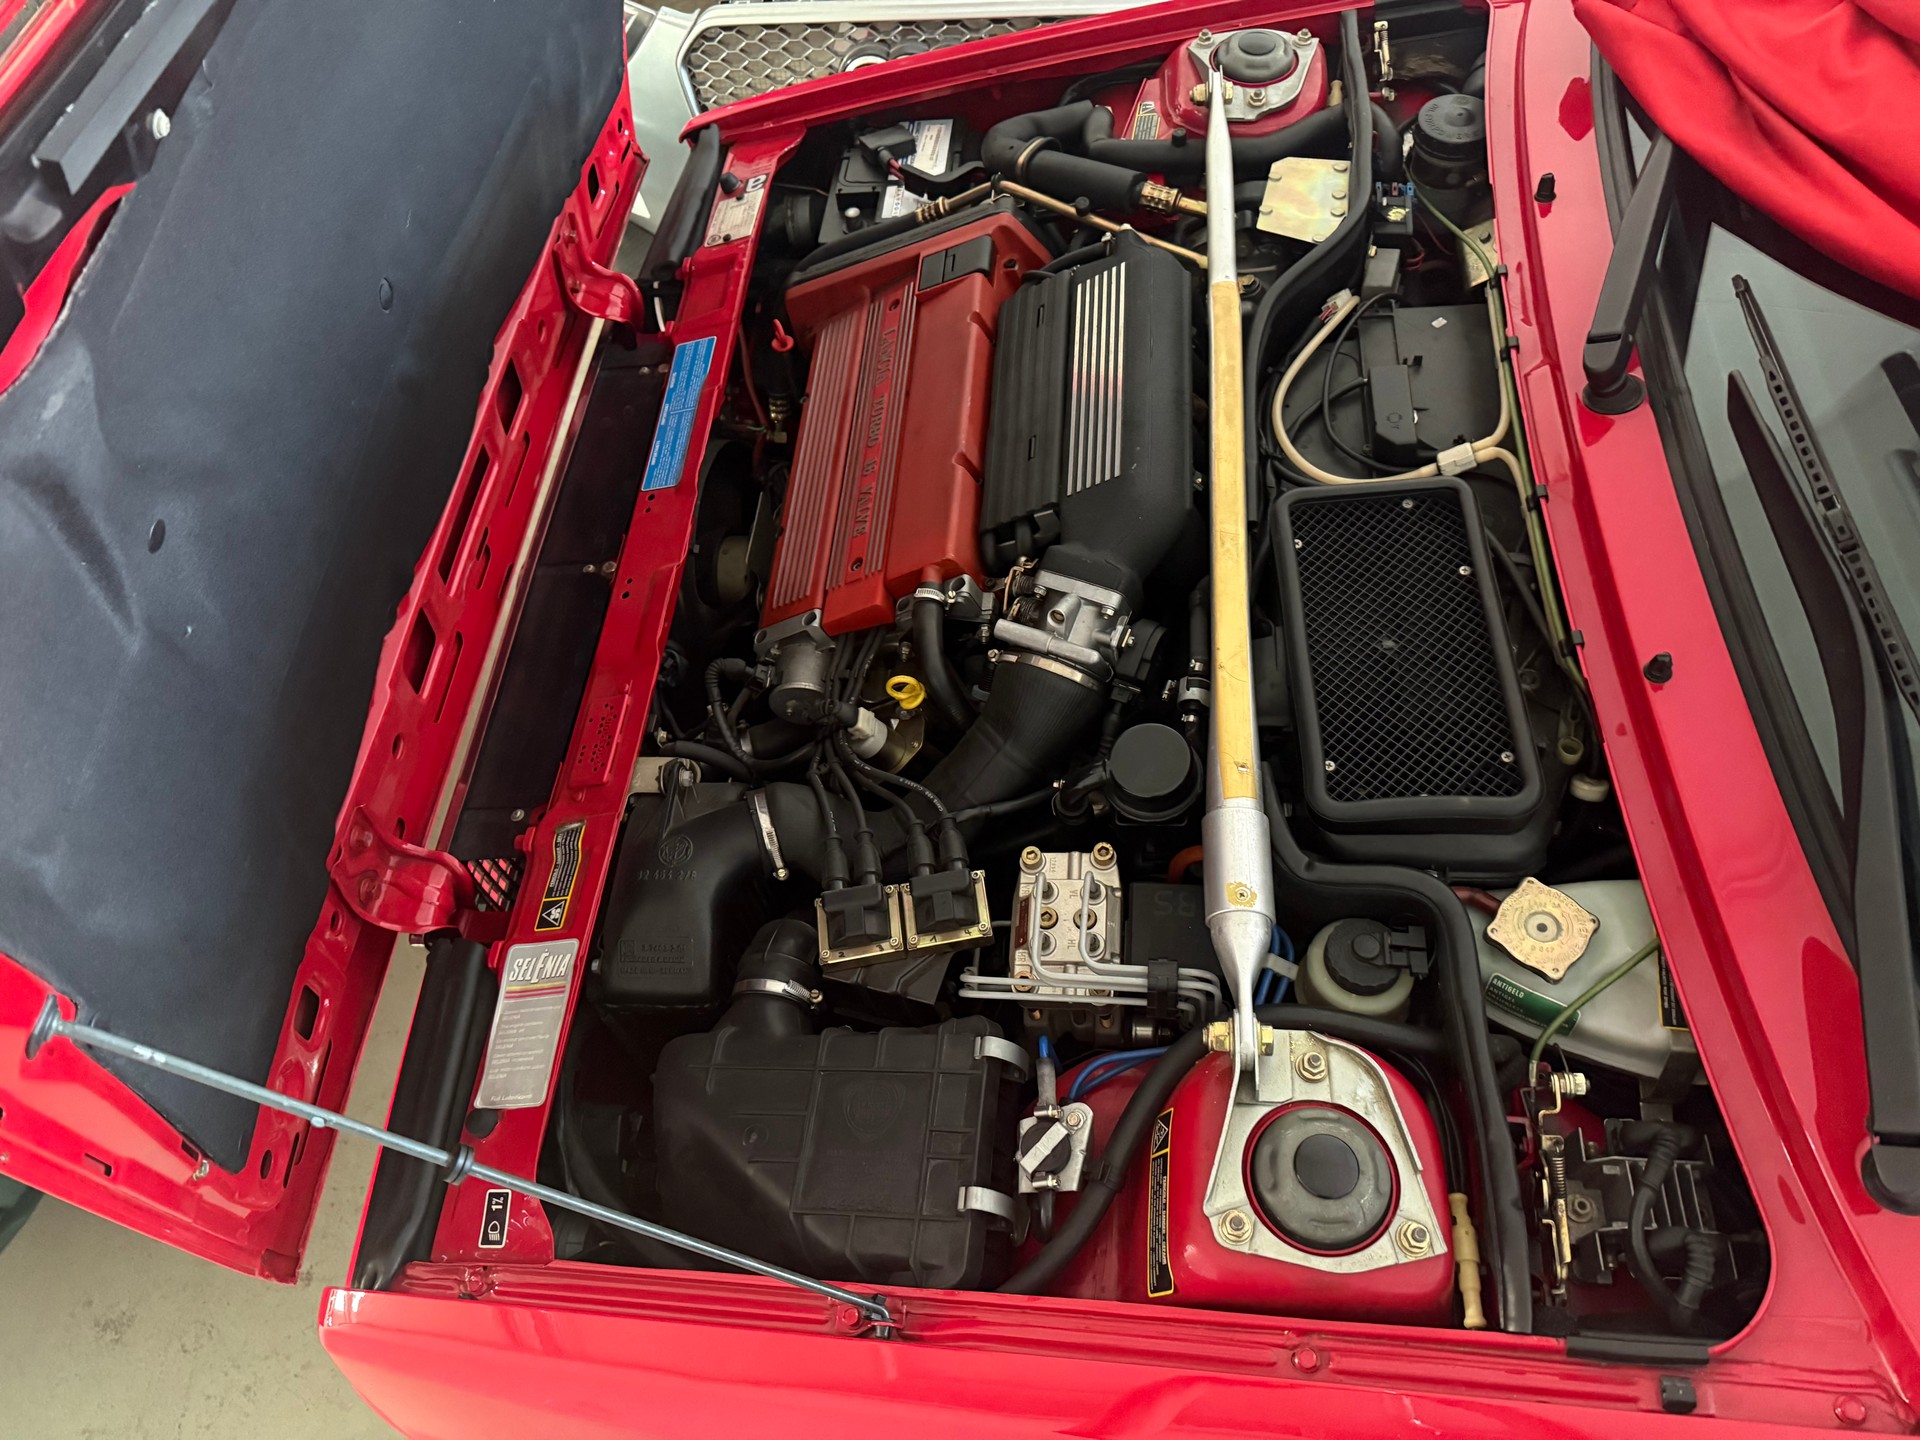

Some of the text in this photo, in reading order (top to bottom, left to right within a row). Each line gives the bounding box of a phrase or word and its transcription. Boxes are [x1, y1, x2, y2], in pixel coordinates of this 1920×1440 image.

[1069, 889, 1079, 899] VL
[963, 929, 972, 937] 4
[875, 944, 884, 952] 3
[1067, 939, 1076, 950] HL
[1017, 951, 1027, 963] HR
[1492, 978, 1525, 999] ANTIGELO
[491, 1196, 504, 1211] 1%
